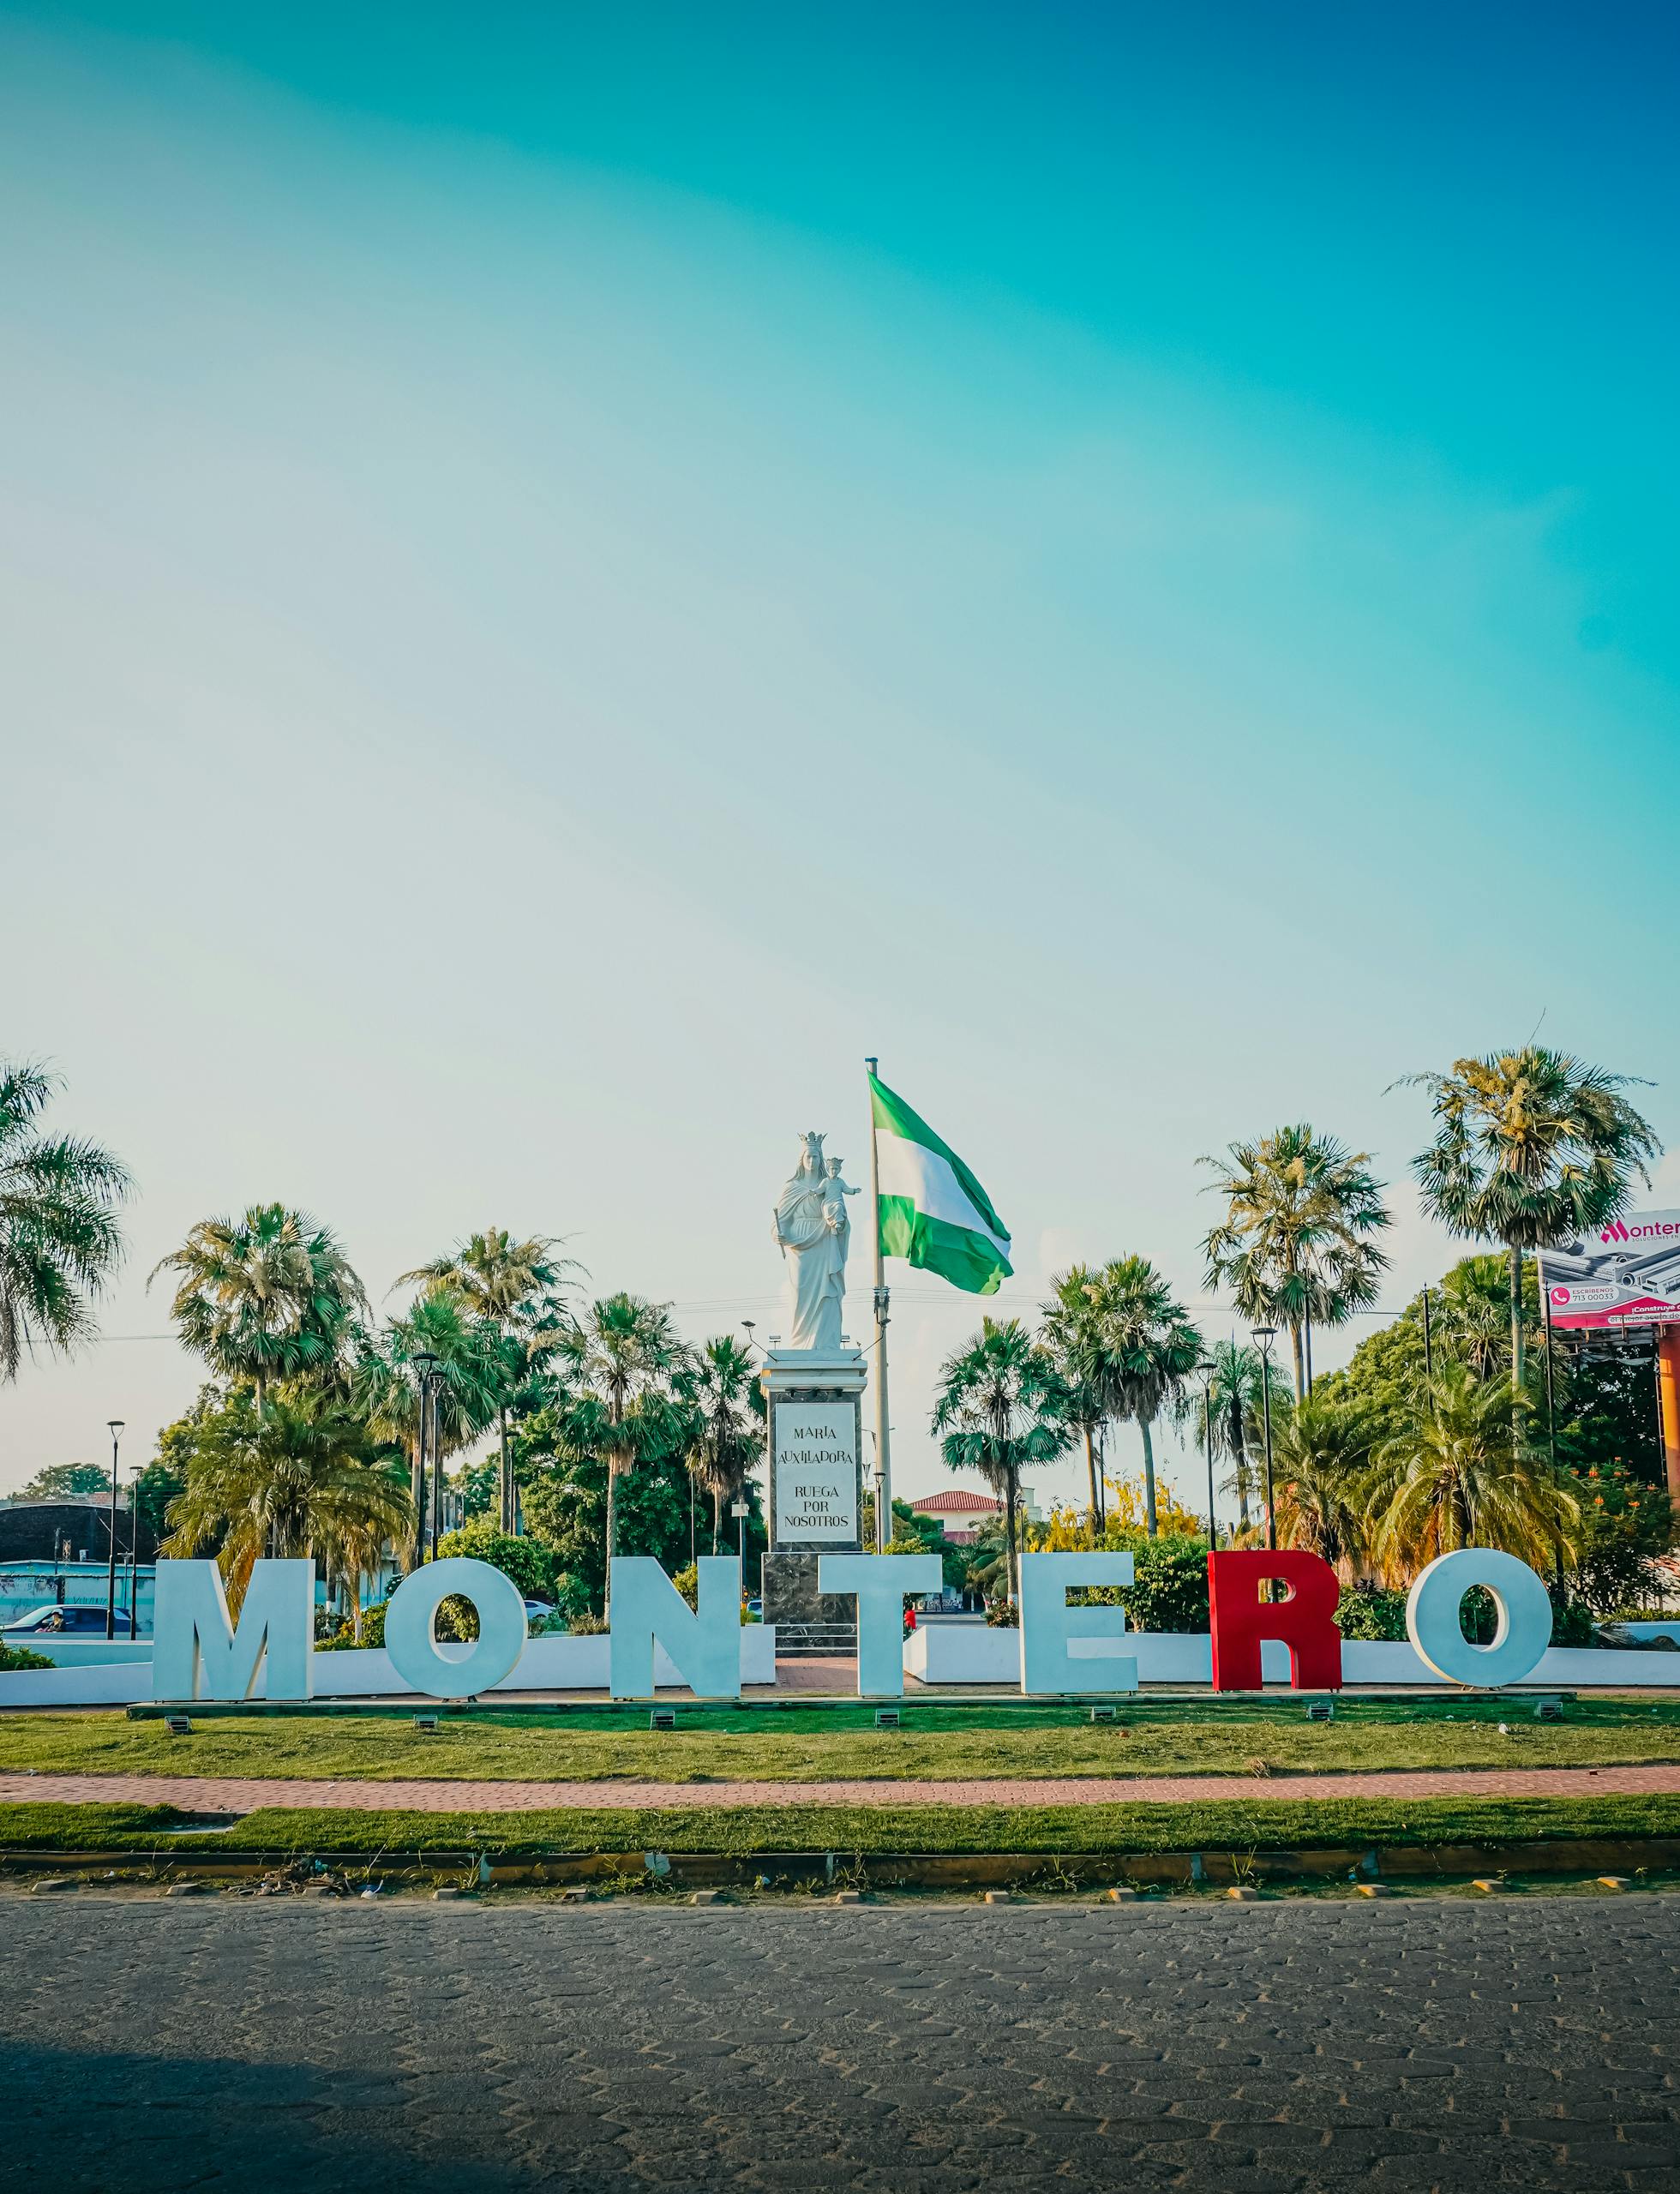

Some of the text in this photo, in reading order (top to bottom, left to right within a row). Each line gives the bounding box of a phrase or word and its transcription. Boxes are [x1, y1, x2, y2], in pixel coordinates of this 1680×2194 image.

[777, 1450, 853, 1465] AUXILIADORA
[795, 1486, 839, 1497] RUEGA
[803, 1501, 829, 1512] POR
[784, 1515, 849, 1527] NOSOTROS
[153, 1548, 1552, 1702] MONTERO
